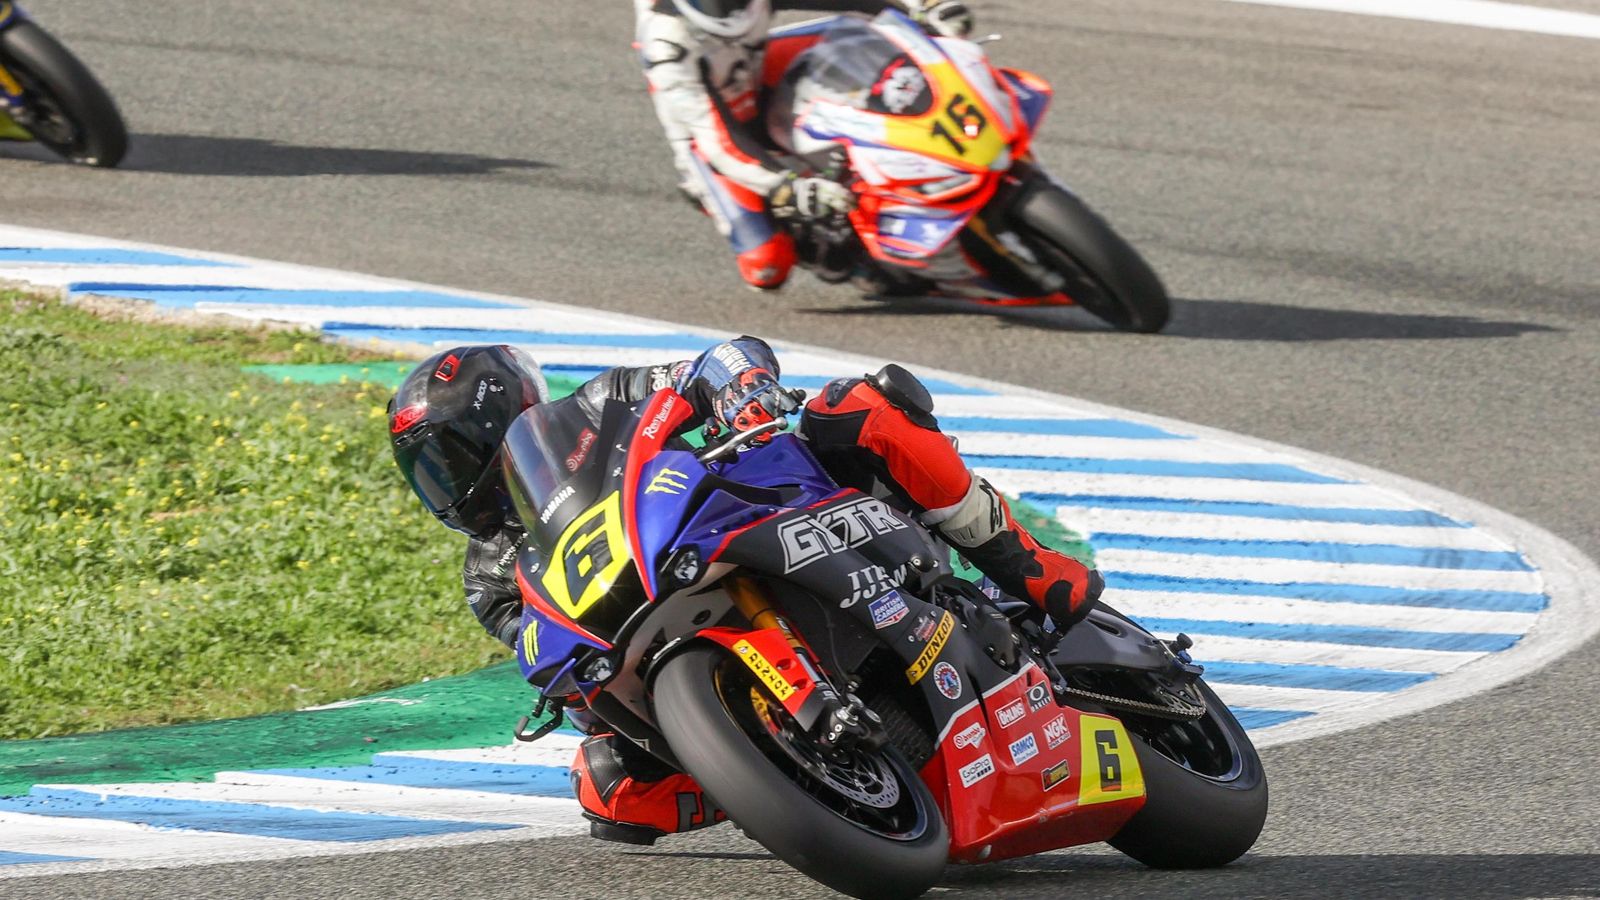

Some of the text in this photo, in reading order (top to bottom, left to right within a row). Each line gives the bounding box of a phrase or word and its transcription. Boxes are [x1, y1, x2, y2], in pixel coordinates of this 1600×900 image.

[540, 485, 576, 524] YAMAHA
[777, 496, 909, 575] GYTR
[917, 614, 950, 672] DUNLOP
[1011, 735, 1034, 757] SAMCO
[1044, 716, 1068, 743] NGK
[962, 758, 990, 778] GoPro
[1095, 729, 1122, 792] 6
